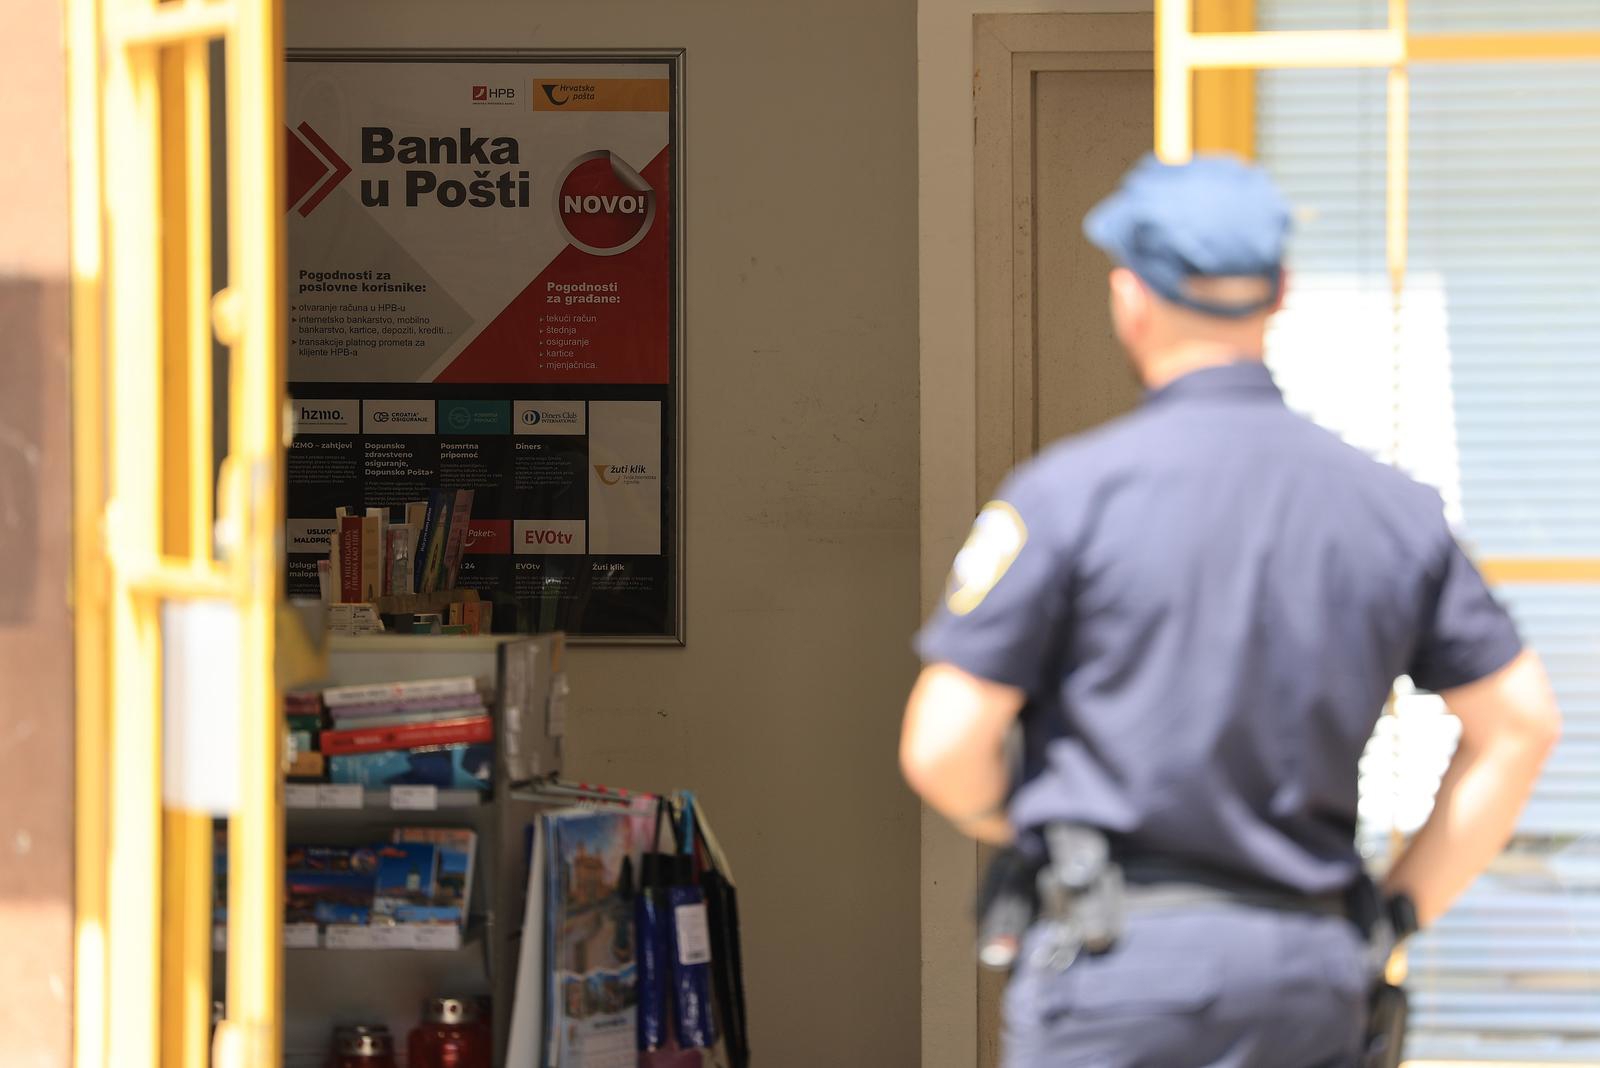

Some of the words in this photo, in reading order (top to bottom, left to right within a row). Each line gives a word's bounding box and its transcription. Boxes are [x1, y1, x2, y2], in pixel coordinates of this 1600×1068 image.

[560, 83, 594, 92] Hrvatska
[489, 88, 515, 98] HPB
[573, 92, 594, 102] pošta
[361, 127, 520, 165] Banka
[361, 180, 389, 208] u
[406, 170, 530, 208] Pošti
[564, 195, 645, 214] NOVO!
[300, 270, 372, 282] Pogodnosti
[376, 272, 391, 280] za
[300, 282, 358, 294] poslovne
[362, 282, 426, 292] korisnike:
[547, 282, 618, 294] Pogodnosti
[546, 295, 560, 304] za
[566, 294, 620, 305] građane:
[299, 304, 337, 313] otvaranje
[340, 304, 368, 312] računa
[378, 304, 406, 312] HPB-u
[299, 316, 344, 324] internetsko
[347, 316, 394, 326] bankarstvo,
[397, 316, 430, 324] mobilno
[546, 314, 570, 322] tekući
[299, 326, 346, 336] bankarstvo,
[350, 326, 380, 336] kartice,
[546, 326, 576, 336] štednja
[299, 338, 344, 348] transakcije
[346, 338, 376, 348] platnog
[378, 338, 412, 348] prometa
[546, 338, 589, 348] osiguranje
[299, 348, 328, 358] klijente
[331, 349, 358, 357] HPB-a
[546, 350, 574, 358] kartice
[320, 442, 352, 450] zahtjevi
[364, 442, 406, 450] Dopunsko
[440, 442, 478, 450] Posmrtna
[515, 442, 542, 450] Diners
[440, 452, 478, 460] pripomoć
[364, 468, 404, 476] Dopunsko
[610, 464, 628, 474] žuti
[630, 464, 646, 474] klik
[525, 530, 573, 544] EVOtv
[290, 562, 317, 570] Usluge
[516, 562, 540, 570] EVOtv
[592, 562, 609, 570] Žuti
[610, 562, 624, 570] klik
